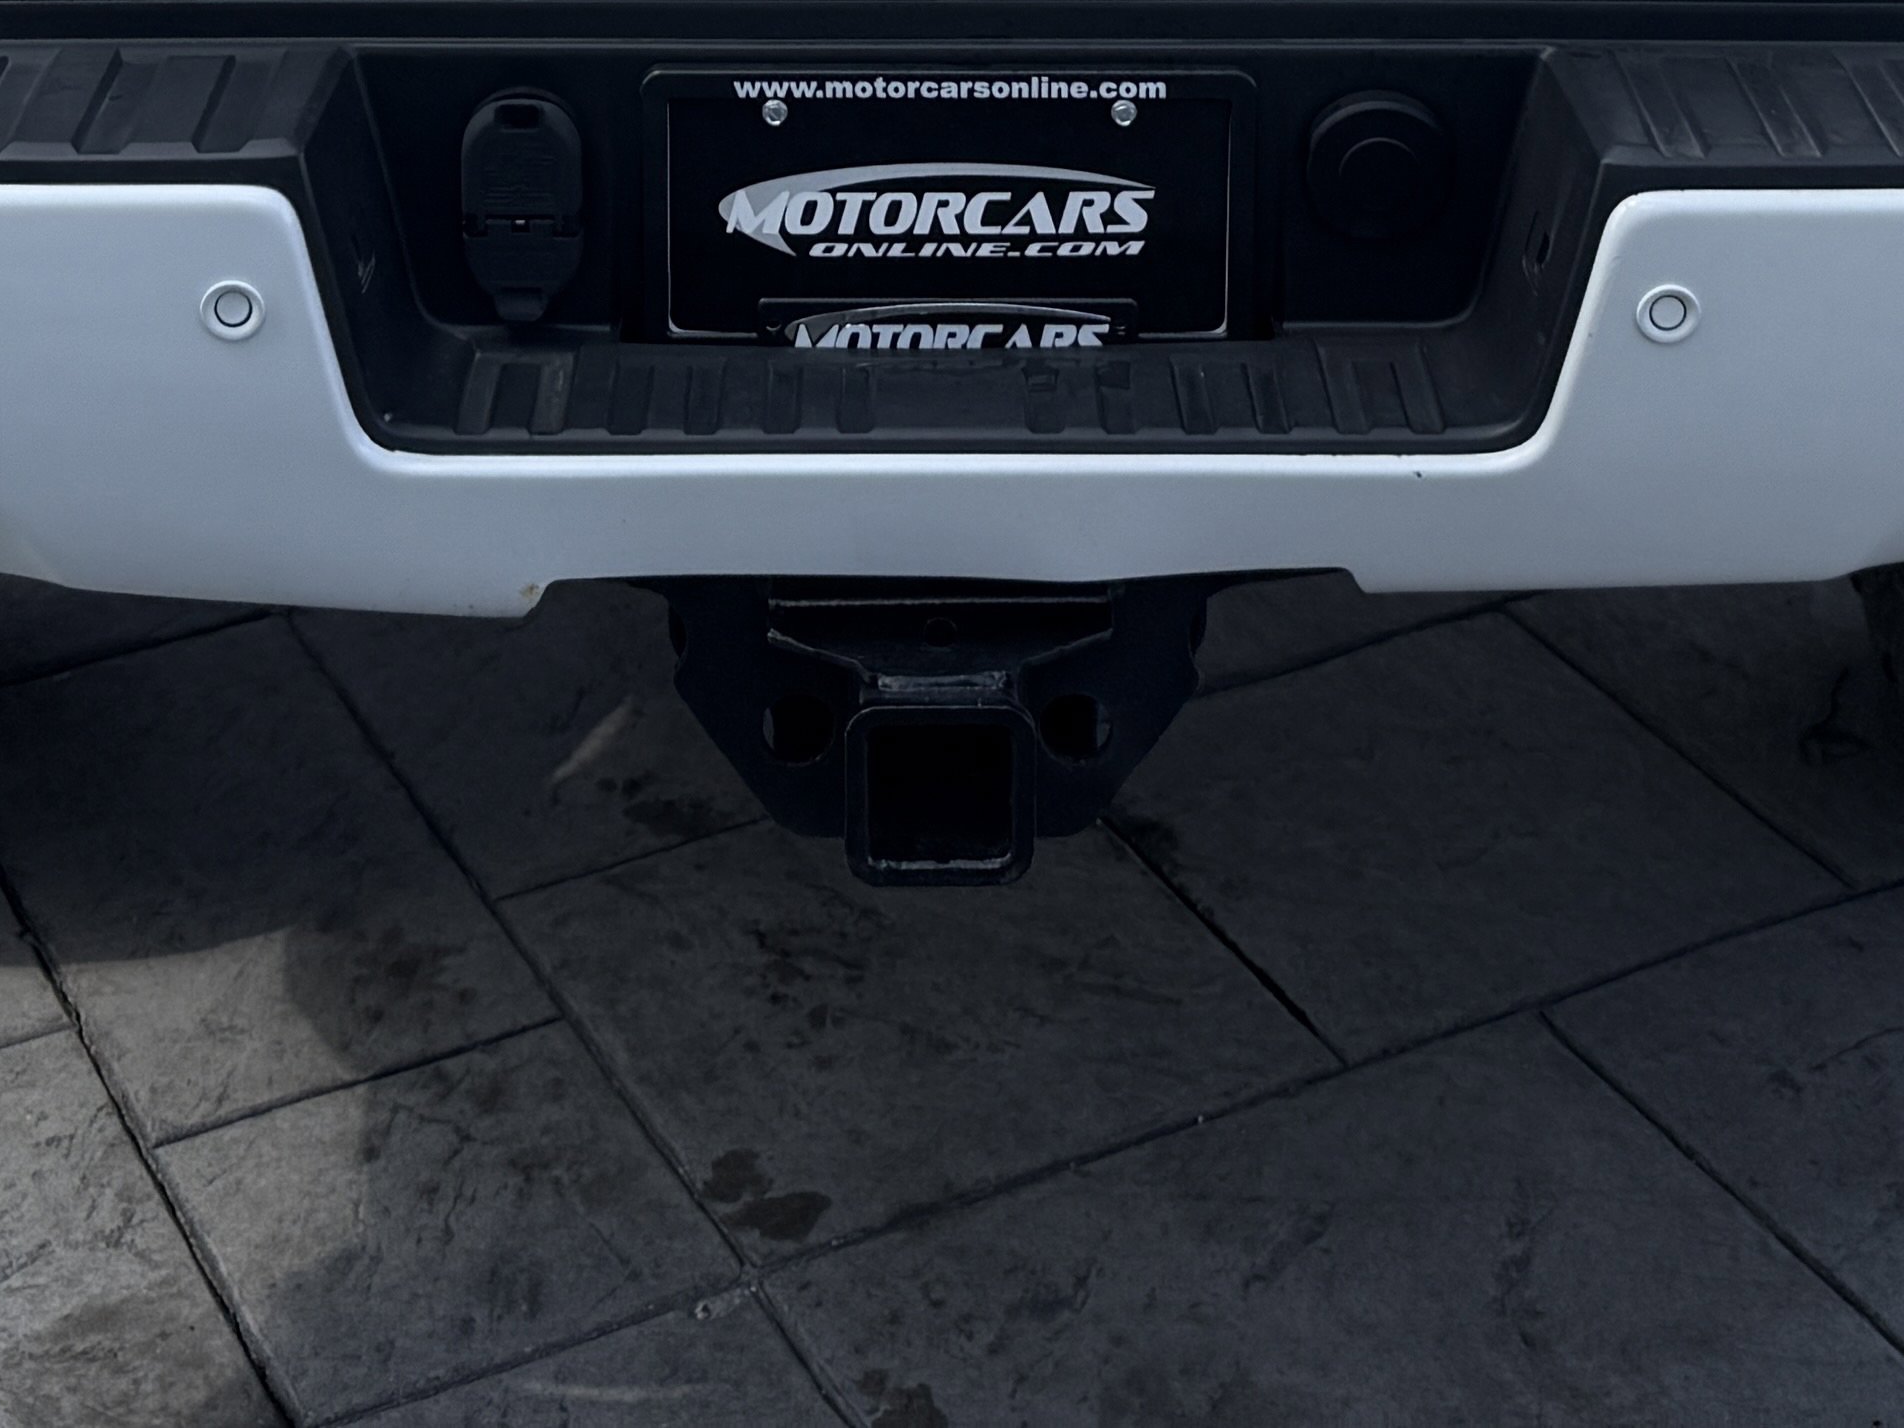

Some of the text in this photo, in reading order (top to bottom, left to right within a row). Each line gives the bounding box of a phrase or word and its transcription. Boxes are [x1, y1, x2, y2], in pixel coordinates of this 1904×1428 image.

[734, 76, 1167, 100] www.motorcarsonline.com
[726, 190, 1156, 236] MOTORCARS
[809, 240, 1146, 258] ONLINE.COM
[795, 323, 1110, 349] MOTORCARS
